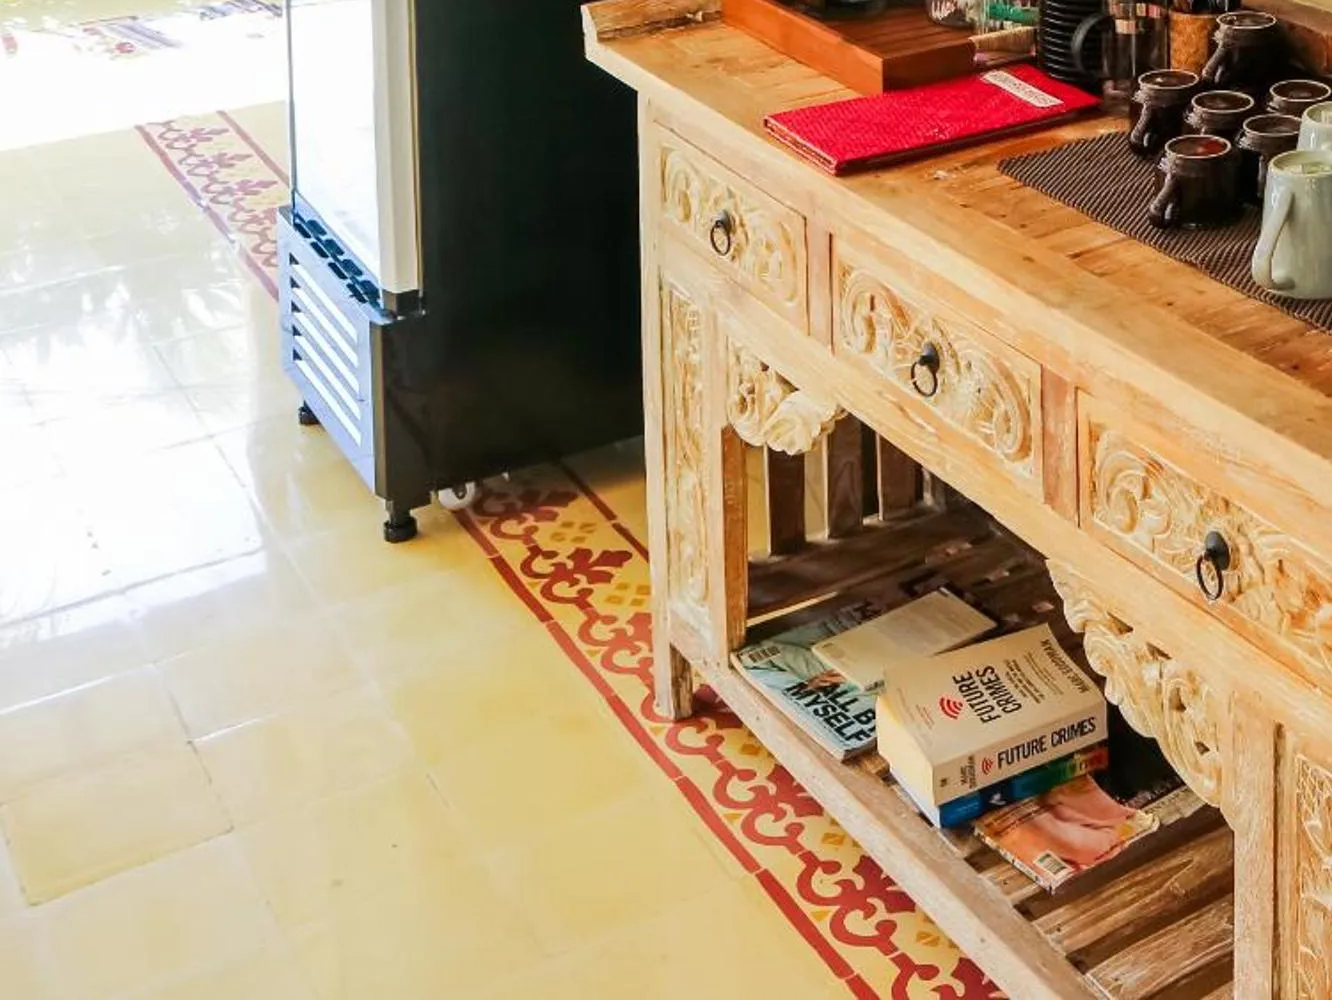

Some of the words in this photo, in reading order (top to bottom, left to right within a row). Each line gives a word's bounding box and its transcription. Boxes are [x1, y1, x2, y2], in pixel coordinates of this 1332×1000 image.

[782, 681, 872, 742] MYSELF
[815, 682, 859, 712] ALL
[952, 671, 1001, 724] FUTURE
[976, 665, 1022, 714] CRIMES
[997, 734, 1047, 769] FUTURE
[1051, 717, 1096, 747] CRIMES
